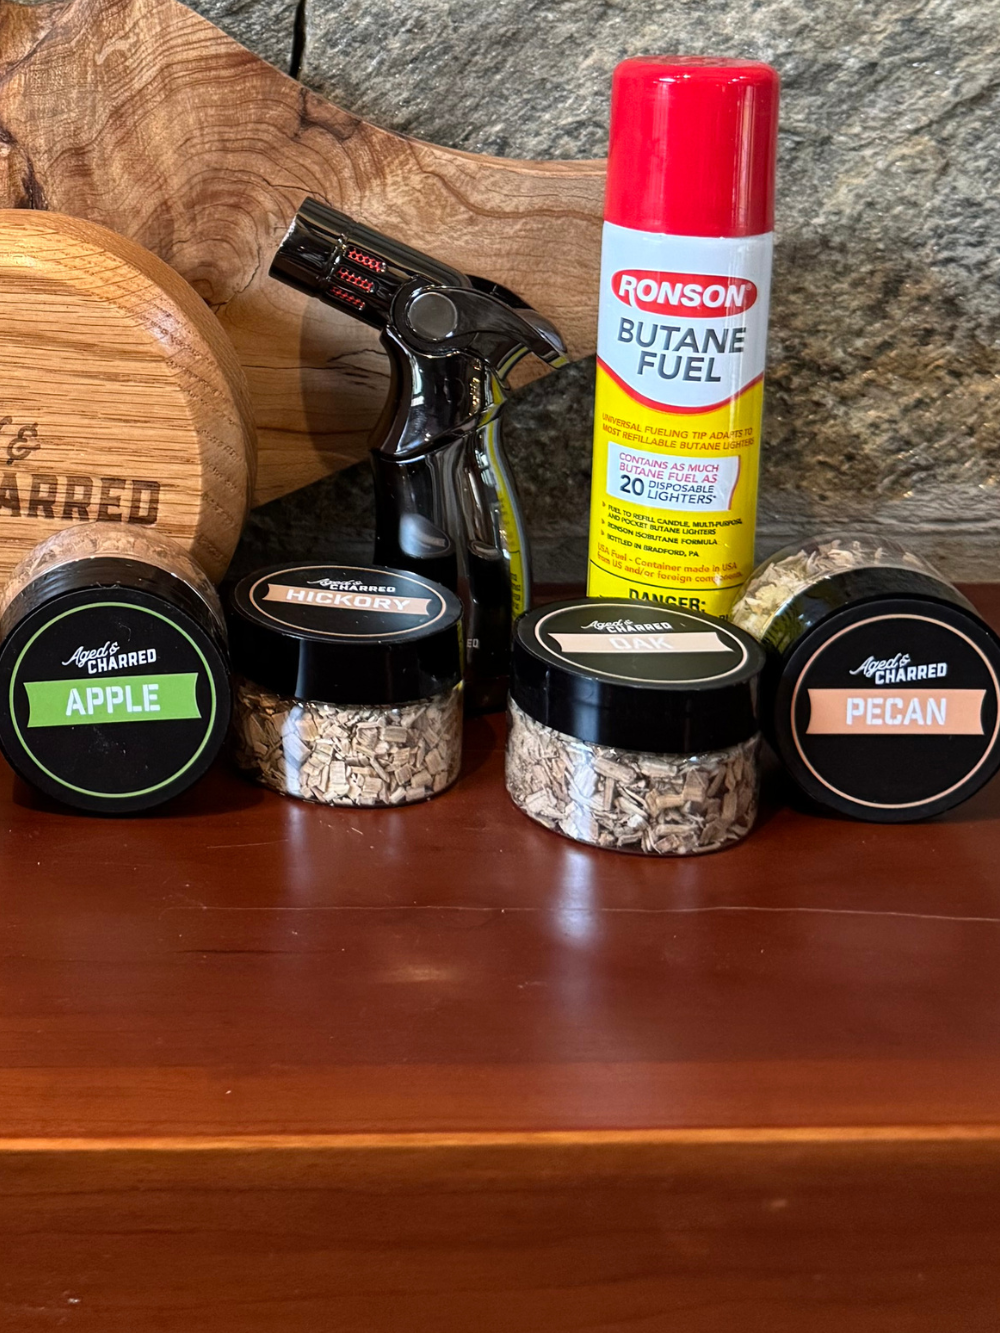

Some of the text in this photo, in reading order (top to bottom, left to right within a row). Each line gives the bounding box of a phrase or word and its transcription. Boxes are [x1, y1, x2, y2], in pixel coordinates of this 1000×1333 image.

[617, 317, 747, 354] BUTANE
[637, 350, 721, 383] FUEL
[602, 412, 753, 440] UNIVERSAL FUELING TIP ADAPTS TO
[602, 423, 755, 451] MOST REFILLABLE BUTANE LIGHTERS
[6, 422, 41, 465] &
[619, 452, 719, 473] CONTAINS AS MUCH
[619, 462, 718, 484] BUTANE FUEL AS
[619, 474, 715, 496] 20 DISPOSABLE
[608, 504, 621, 516] FUEL
[623, 509, 632, 518] TO
[633, 513, 655, 524] REFILL
[657, 518, 691, 528] CANDLE,
[608, 513, 716, 536] AND POCKET BUTANE LIGHTERS
[607, 521, 718, 546] RONSON ISOBUTANE FORMULA
[607, 533, 632, 547] BOTTLED
[634, 542, 642, 550] IN
[689, 550, 699, 558] PA
[597, 542, 610, 556] USA
[611, 549, 628, 562] Fuel
[635, 556, 682, 572] Container
[684, 562, 709, 573] made
[712, 562, 720, 572] in
[722, 561, 738, 571] USA
[597, 551, 611, 566] from
[612, 559, 623, 570] US
[624, 565, 654, 580] and/or
[657, 569, 692, 584] foreign
[285, 589, 411, 611] HICKORY
[329, 583, 396, 593] CHARRED
[580, 619, 624, 631] Aged
[606, 621, 674, 634] CHARRED
[61, 641, 111, 668] Aged
[608, 636, 674, 650] OAK
[87, 648, 157, 675] CHARRED
[848, 652, 902, 678] Aged
[874, 662, 948, 685] CHARRED
[65, 683, 161, 717] APPLE
[845, 697, 947, 726] PECAN
